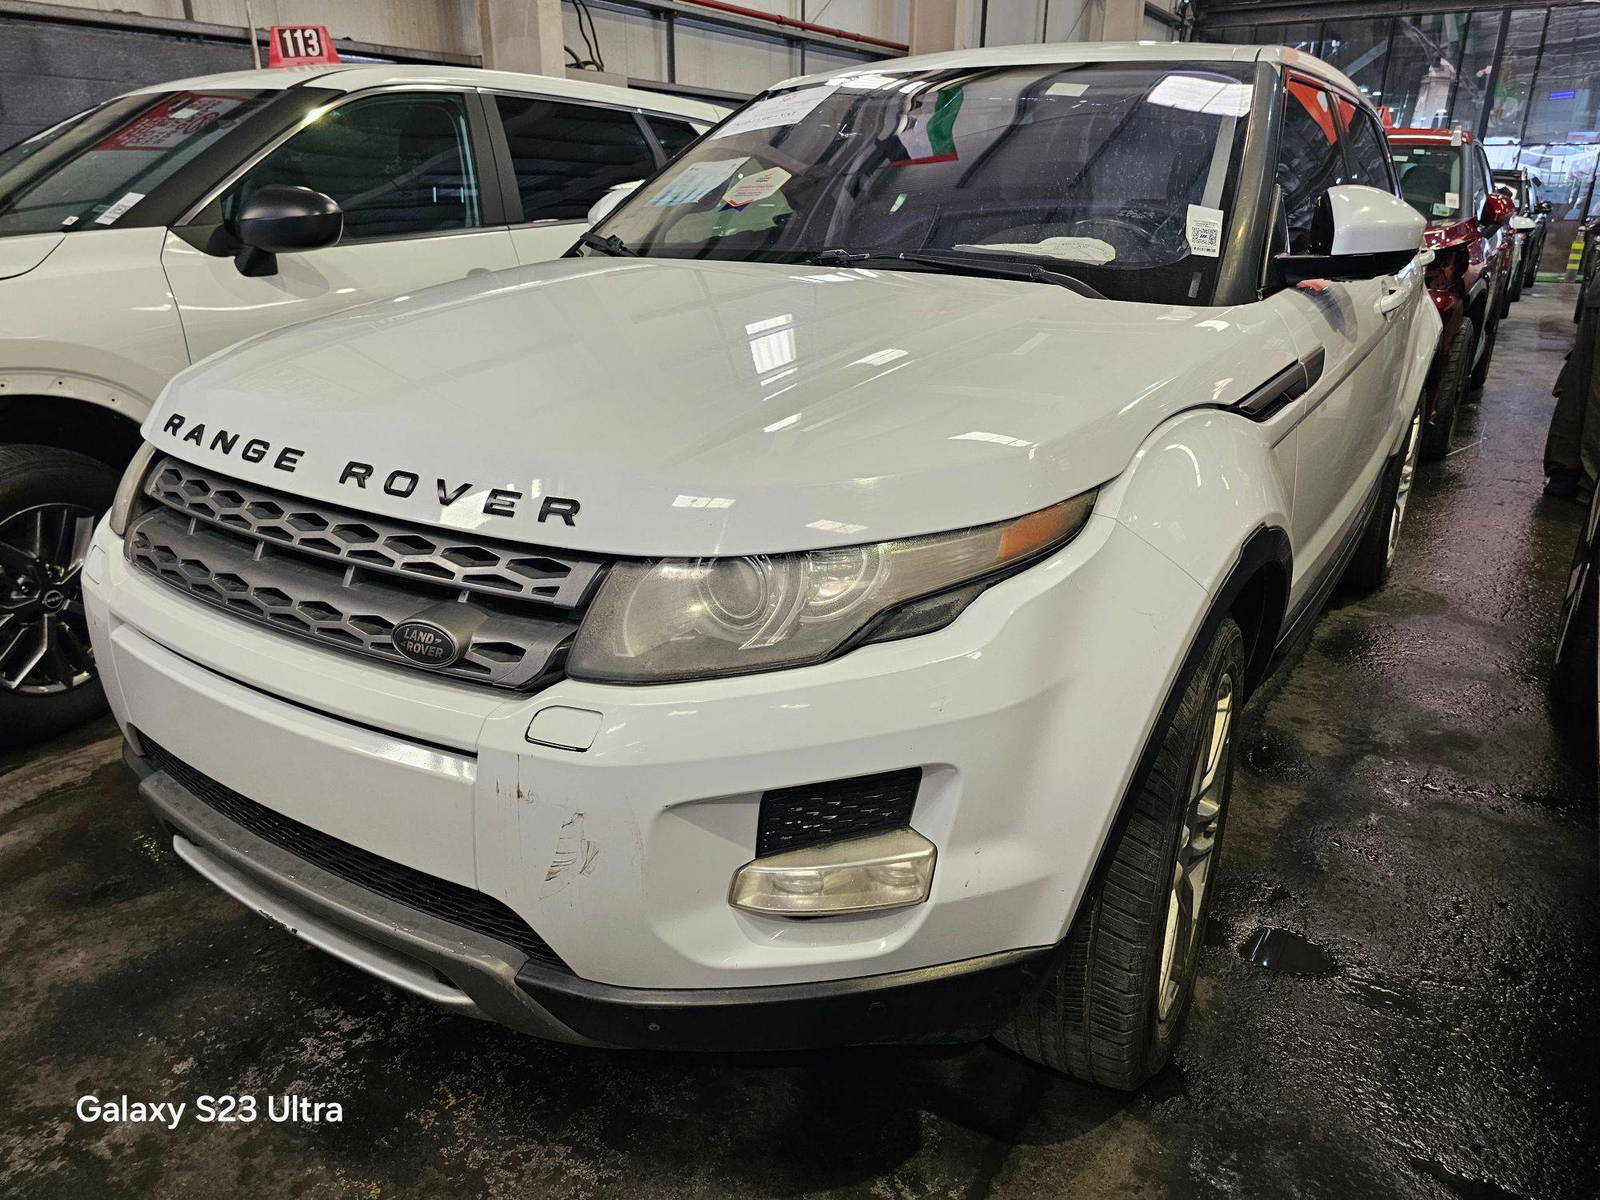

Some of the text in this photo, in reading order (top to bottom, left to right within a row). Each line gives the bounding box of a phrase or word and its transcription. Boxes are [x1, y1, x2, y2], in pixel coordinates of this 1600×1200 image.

[282, 29, 320, 57] 113
[163, 413, 582, 527] RANGE ROVER
[406, 641, 443, 658] ROVER
